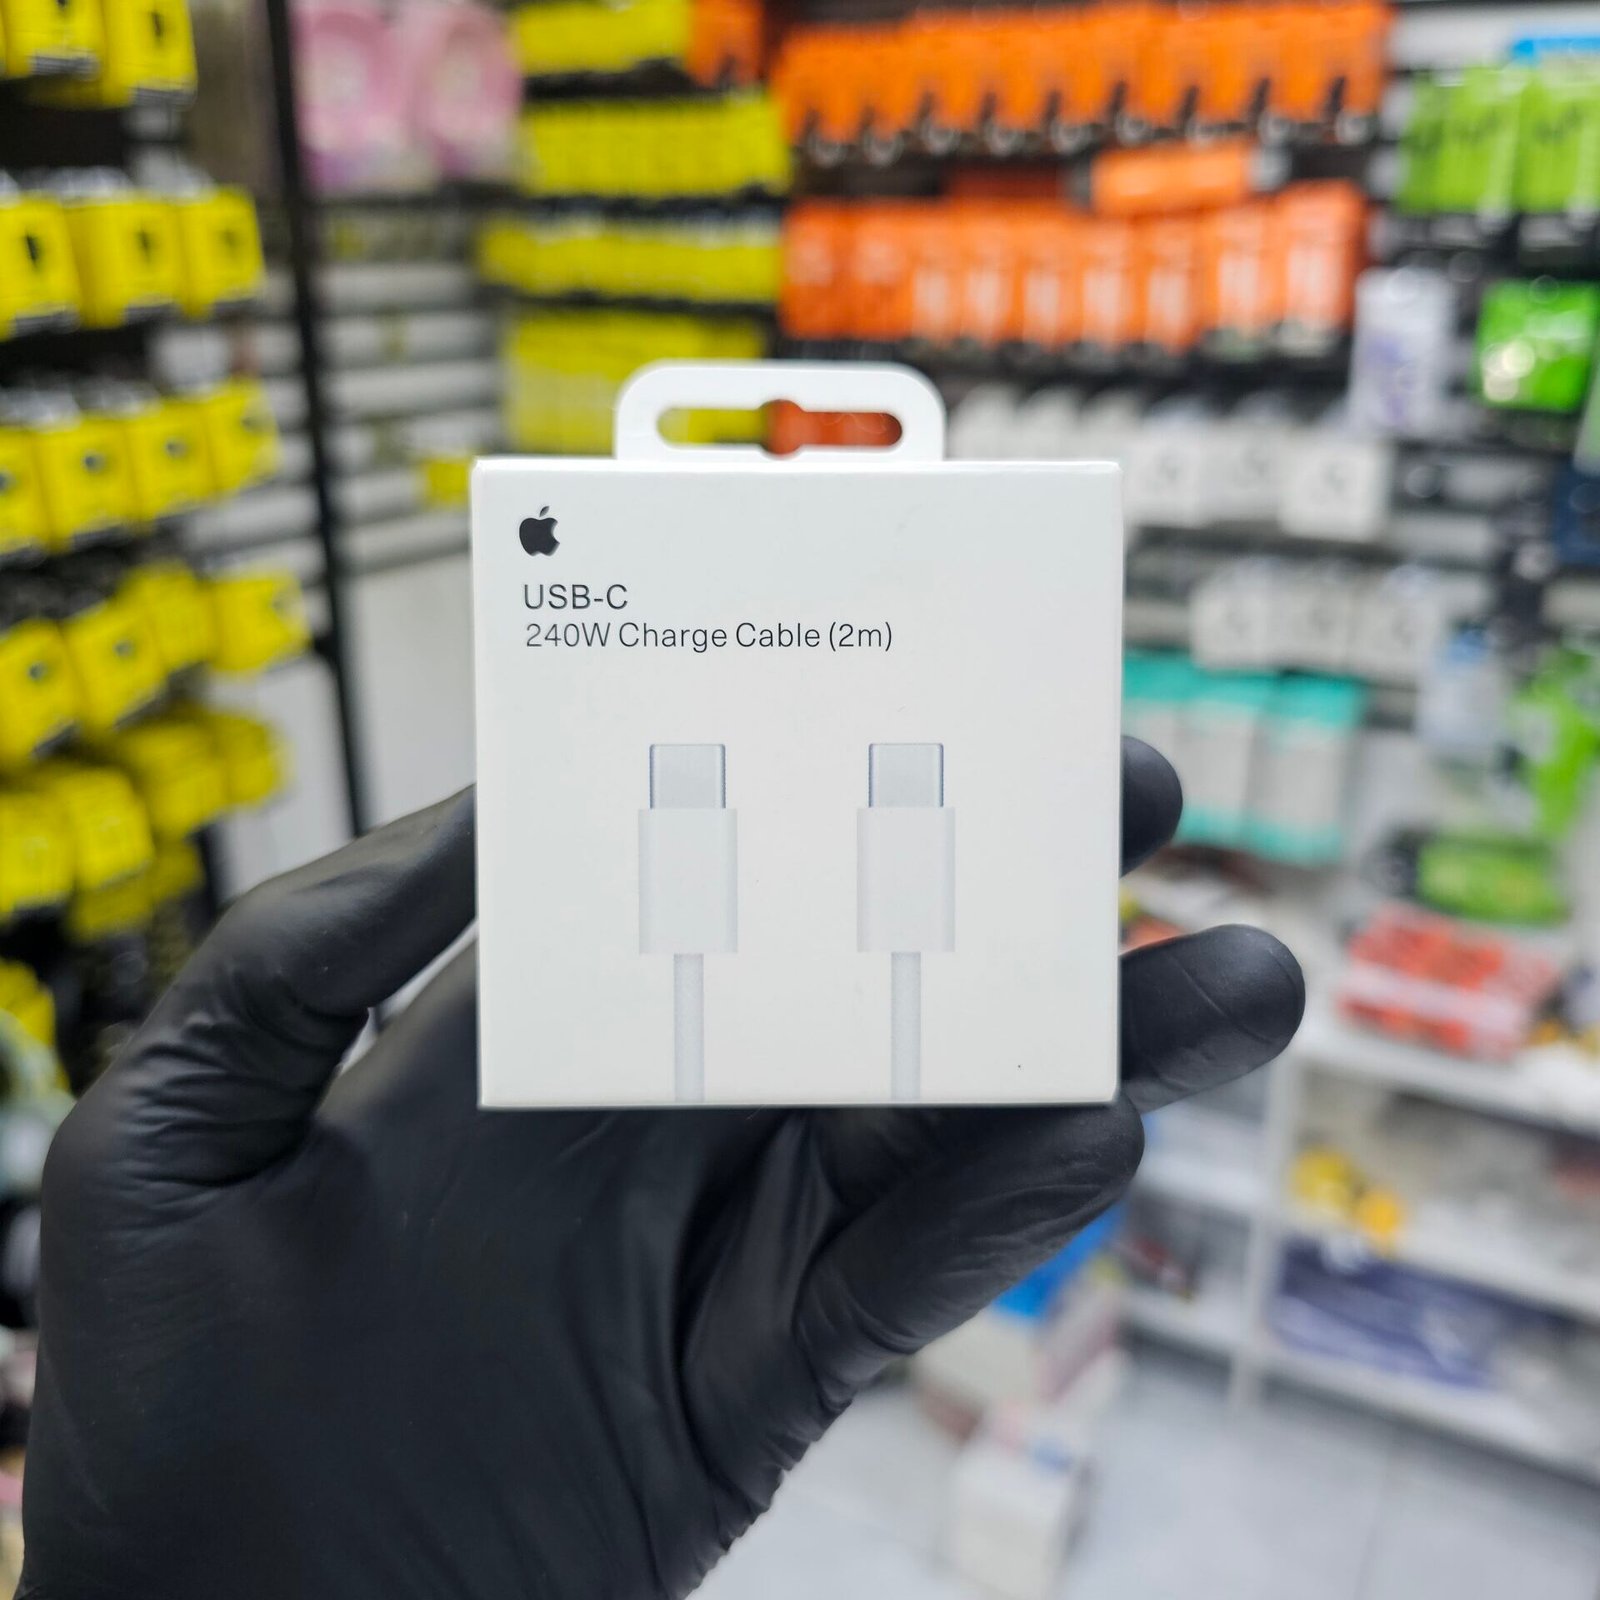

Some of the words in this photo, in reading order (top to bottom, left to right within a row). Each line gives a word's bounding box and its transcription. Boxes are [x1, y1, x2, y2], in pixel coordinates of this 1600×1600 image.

[524, 583, 628, 610] USB-C
[526, 622, 611, 648] 240W
[618, 621, 728, 654] Charge
[735, 622, 821, 648] Cable
[829, 621, 892, 652] (2m)
